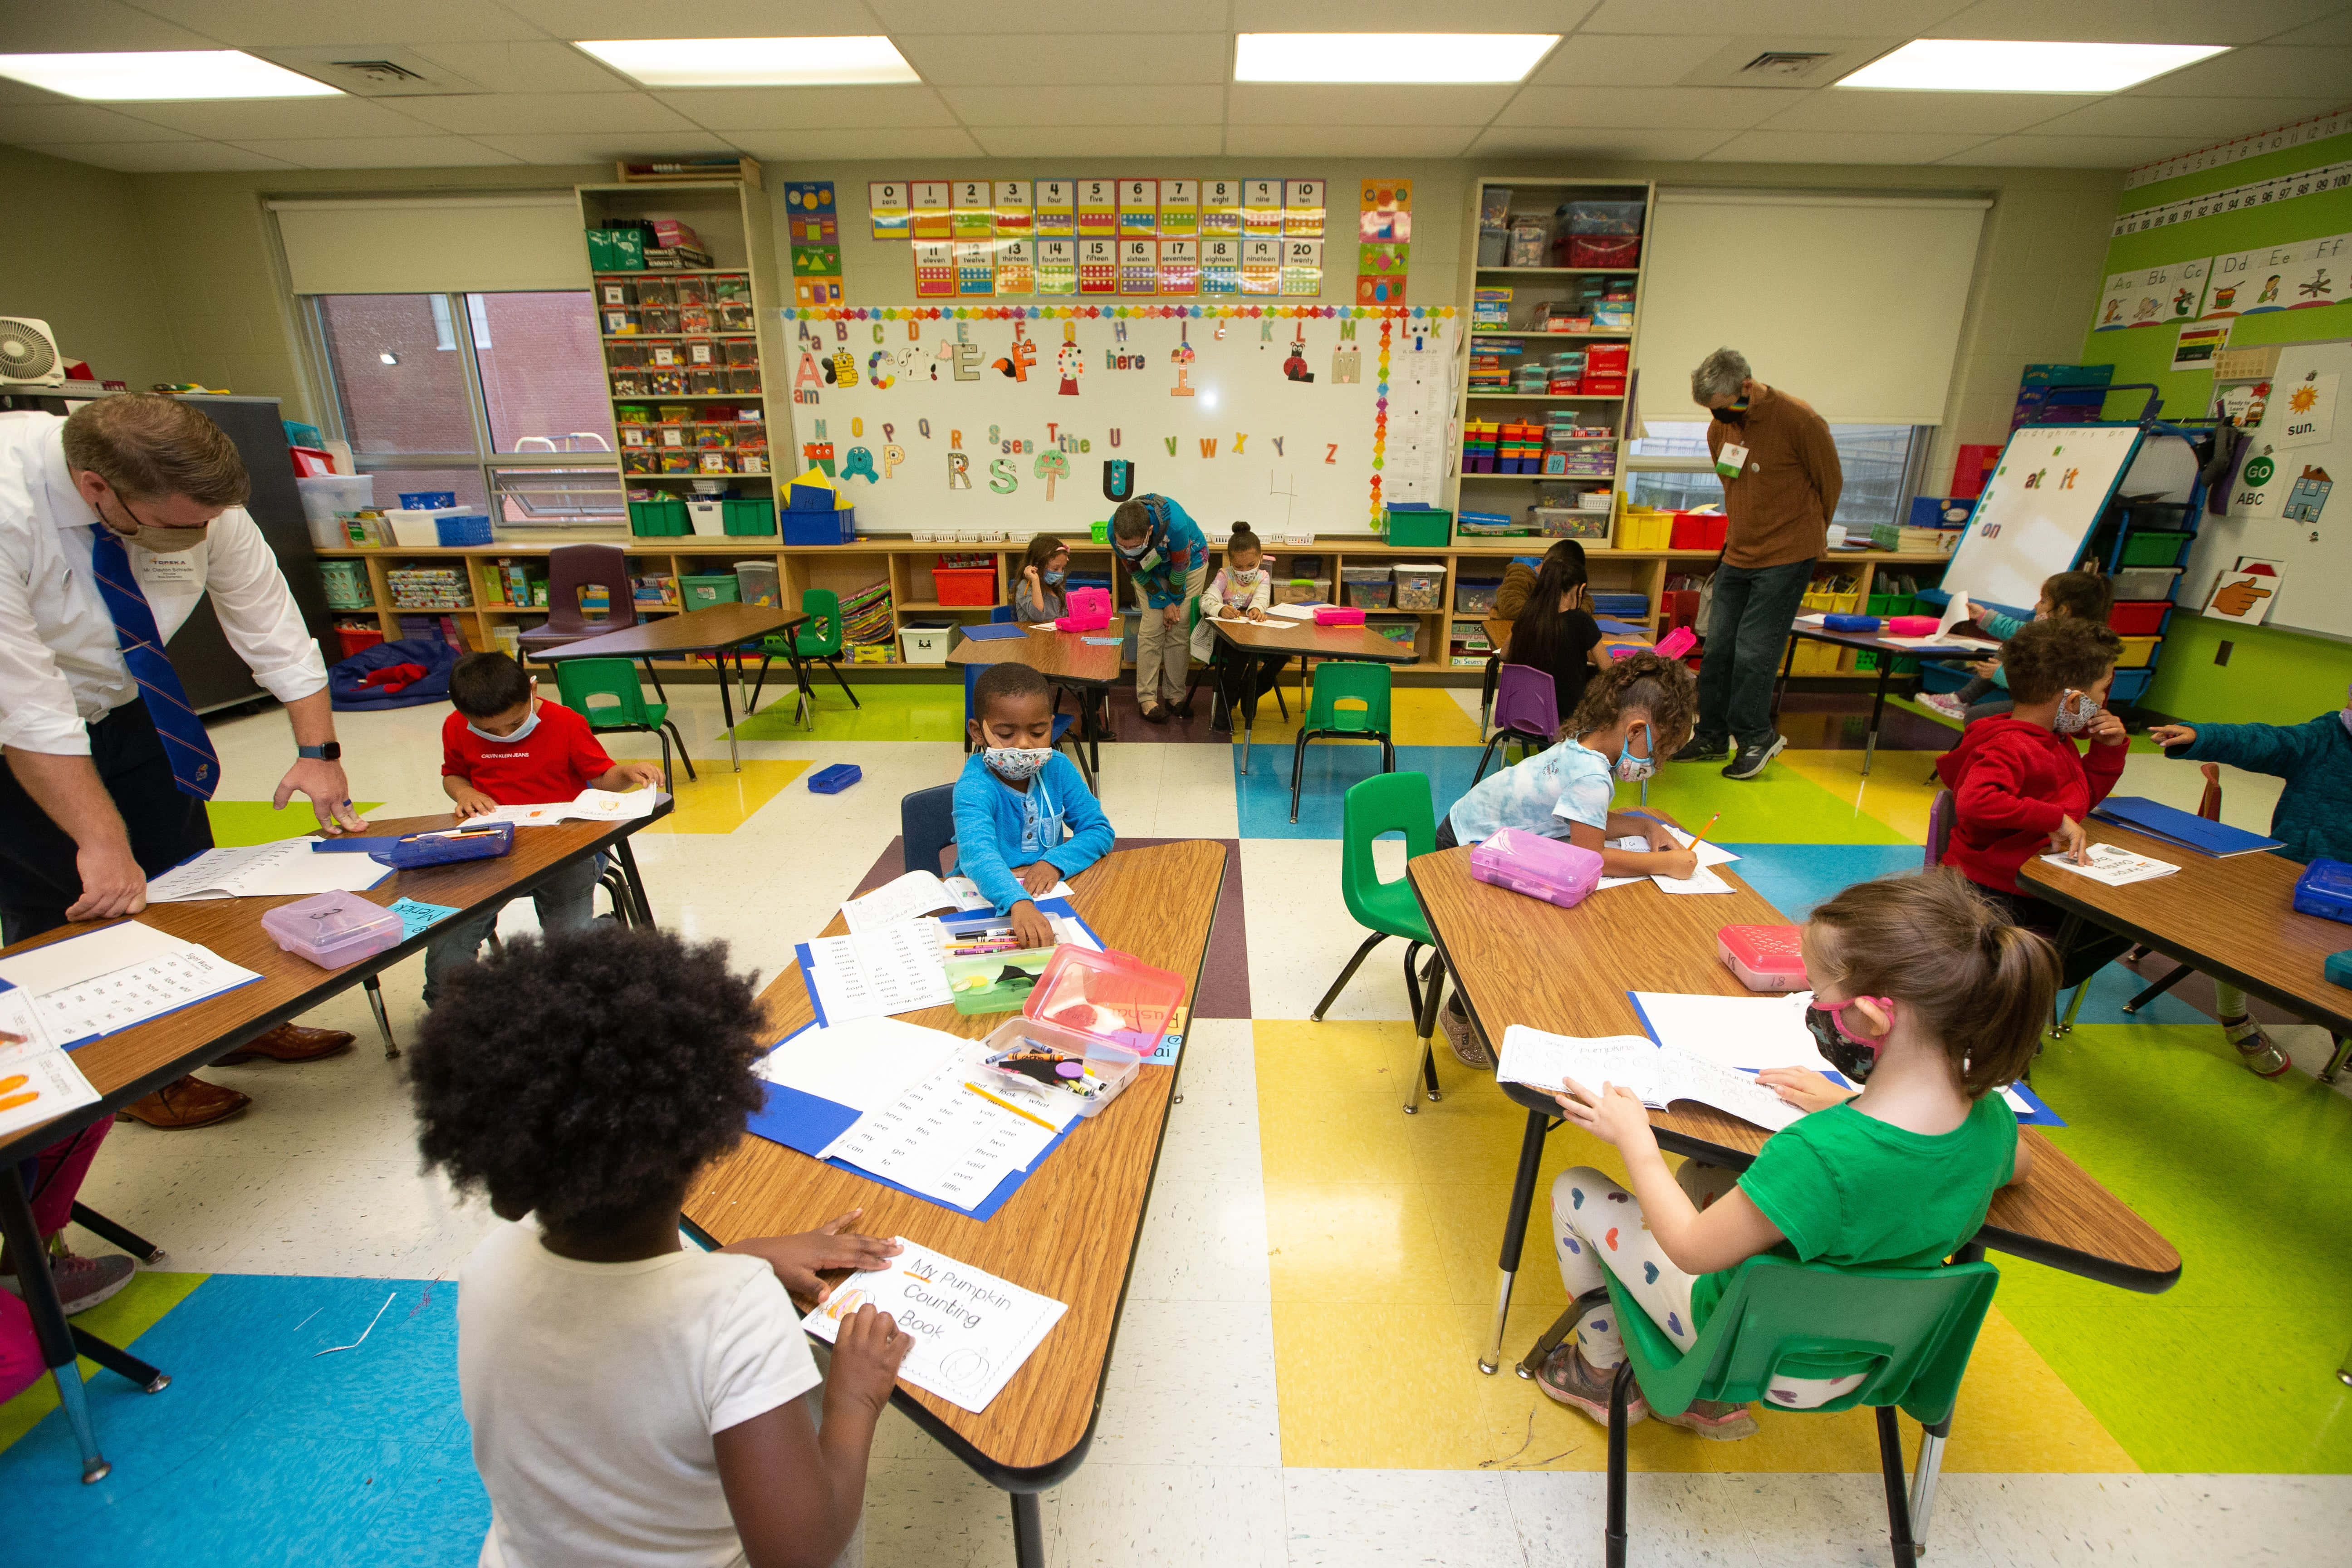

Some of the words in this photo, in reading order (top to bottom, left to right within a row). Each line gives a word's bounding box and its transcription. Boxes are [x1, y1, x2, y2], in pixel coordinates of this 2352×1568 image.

[884, 186, 894, 197] 0
[928, 185, 932, 197] 1
[967, 184, 975, 196] 2
[1009, 183, 1018, 195] 3
[1050, 183, 1059, 196] 4
[1092, 183, 1100, 195] 5
[1133, 182, 1142, 195] 6
[1175, 182, 1183, 194] 7
[1216, 182, 1225, 195] 8
[1259, 182, 1268, 195] 9
[1299, 183, 1313, 195] 10
[1047, 196, 1062, 204] four
[1211, 195, 1229, 205] eight
[2183, 209, 2193, 221] 91
[2196, 205, 2209, 218] 92
[2212, 202, 2224, 215] 93
[2227, 198, 2240, 211] 94
[2244, 195, 2256, 208] 95
[2261, 191, 2274, 204] 96
[2278, 186, 2292, 201] 97
[2296, 182, 2310, 197] 98
[2315, 178, 2328, 193] 99
[928, 245, 940, 256] 11
[968, 244, 980, 255] 12
[1007, 242, 1021, 255] 13
[1049, 243, 1062, 255] 14
[1091, 242, 1103, 254] 15
[1132, 242, 1144, 254] 16
[1172, 242, 1184, 254] 17
[1213, 242, 1226, 255] 18
[1255, 243, 1267, 255] 19
[1293, 243, 1312, 255] 20
[1086, 254, 1109, 262] fifteen
[1205, 255, 1234, 264] eighteen
[1291, 257, 1313, 265] twenty
[798, 319, 812, 341] A
[835, 320, 848, 341] B
[872, 323, 884, 345] C
[906, 318, 920, 341] D
[956, 322, 969, 344] E
[1014, 320, 1025, 343] F
[1063, 321, 1075, 343] G
[1114, 320, 1128, 342] H
[1181, 321, 1187, 343] I
[1214, 319, 1226, 341] J
[1260, 319, 1274, 343] K
[1296, 321, 1306, 343] L
[1340, 319, 1356, 341] M
[810, 335, 822, 351] a
[1106, 349, 1145, 370] here
[794, 389, 820, 405] am
[2288, 421, 2316, 436] sun.
[814, 419, 828, 441] N
[852, 417, 863, 438] O
[882, 422, 894, 443] P
[918, 418, 931, 440] Q
[951, 429, 962, 450] R
[989, 424, 1000, 445] S
[1047, 422, 1058, 443] T
[1110, 428, 1121, 448] U
[1164, 436, 1177, 457] V
[1200, 438, 1217, 459] W
[1232, 432, 1248, 455] X
[1271, 436, 1284, 457] Y
[1325, 443, 1338, 465] Z
[1056, 434, 1090, 454] the
[1001, 440, 1033, 455] see
[2247, 465, 2271, 479] GO
[2024, 468, 2047, 490] at
[2059, 468, 2079, 490] it
[1270, 468, 1298, 525] 4
[2237, 492, 2264, 505] ABC
[1980, 523, 2002, 539] on
[922, 1083, 933, 1091] for
[962, 1088, 974, 1097] we
[999, 1088, 1018, 1098] look
[898, 1102, 911, 1110] the
[1029, 1097, 1049, 1108] what
[883, 1111, 902, 1121] here
[873, 1122, 888, 1131] see
[916, 1127, 930, 1136] this
[861, 1133, 875, 1142] my
[990, 1138, 1005, 1147] two
[846, 1144, 864, 1154] can
[975, 1148, 998, 1158] three
[967, 1161, 986, 1169] said
[953, 1172, 973, 1181] over
[941, 1181, 960, 1191] little
[911, 1258, 938, 1280] My
[940, 1271, 1011, 1310] Pumpkin
[903, 1284, 982, 1330] Counting
[897, 1309, 944, 1339] Book
